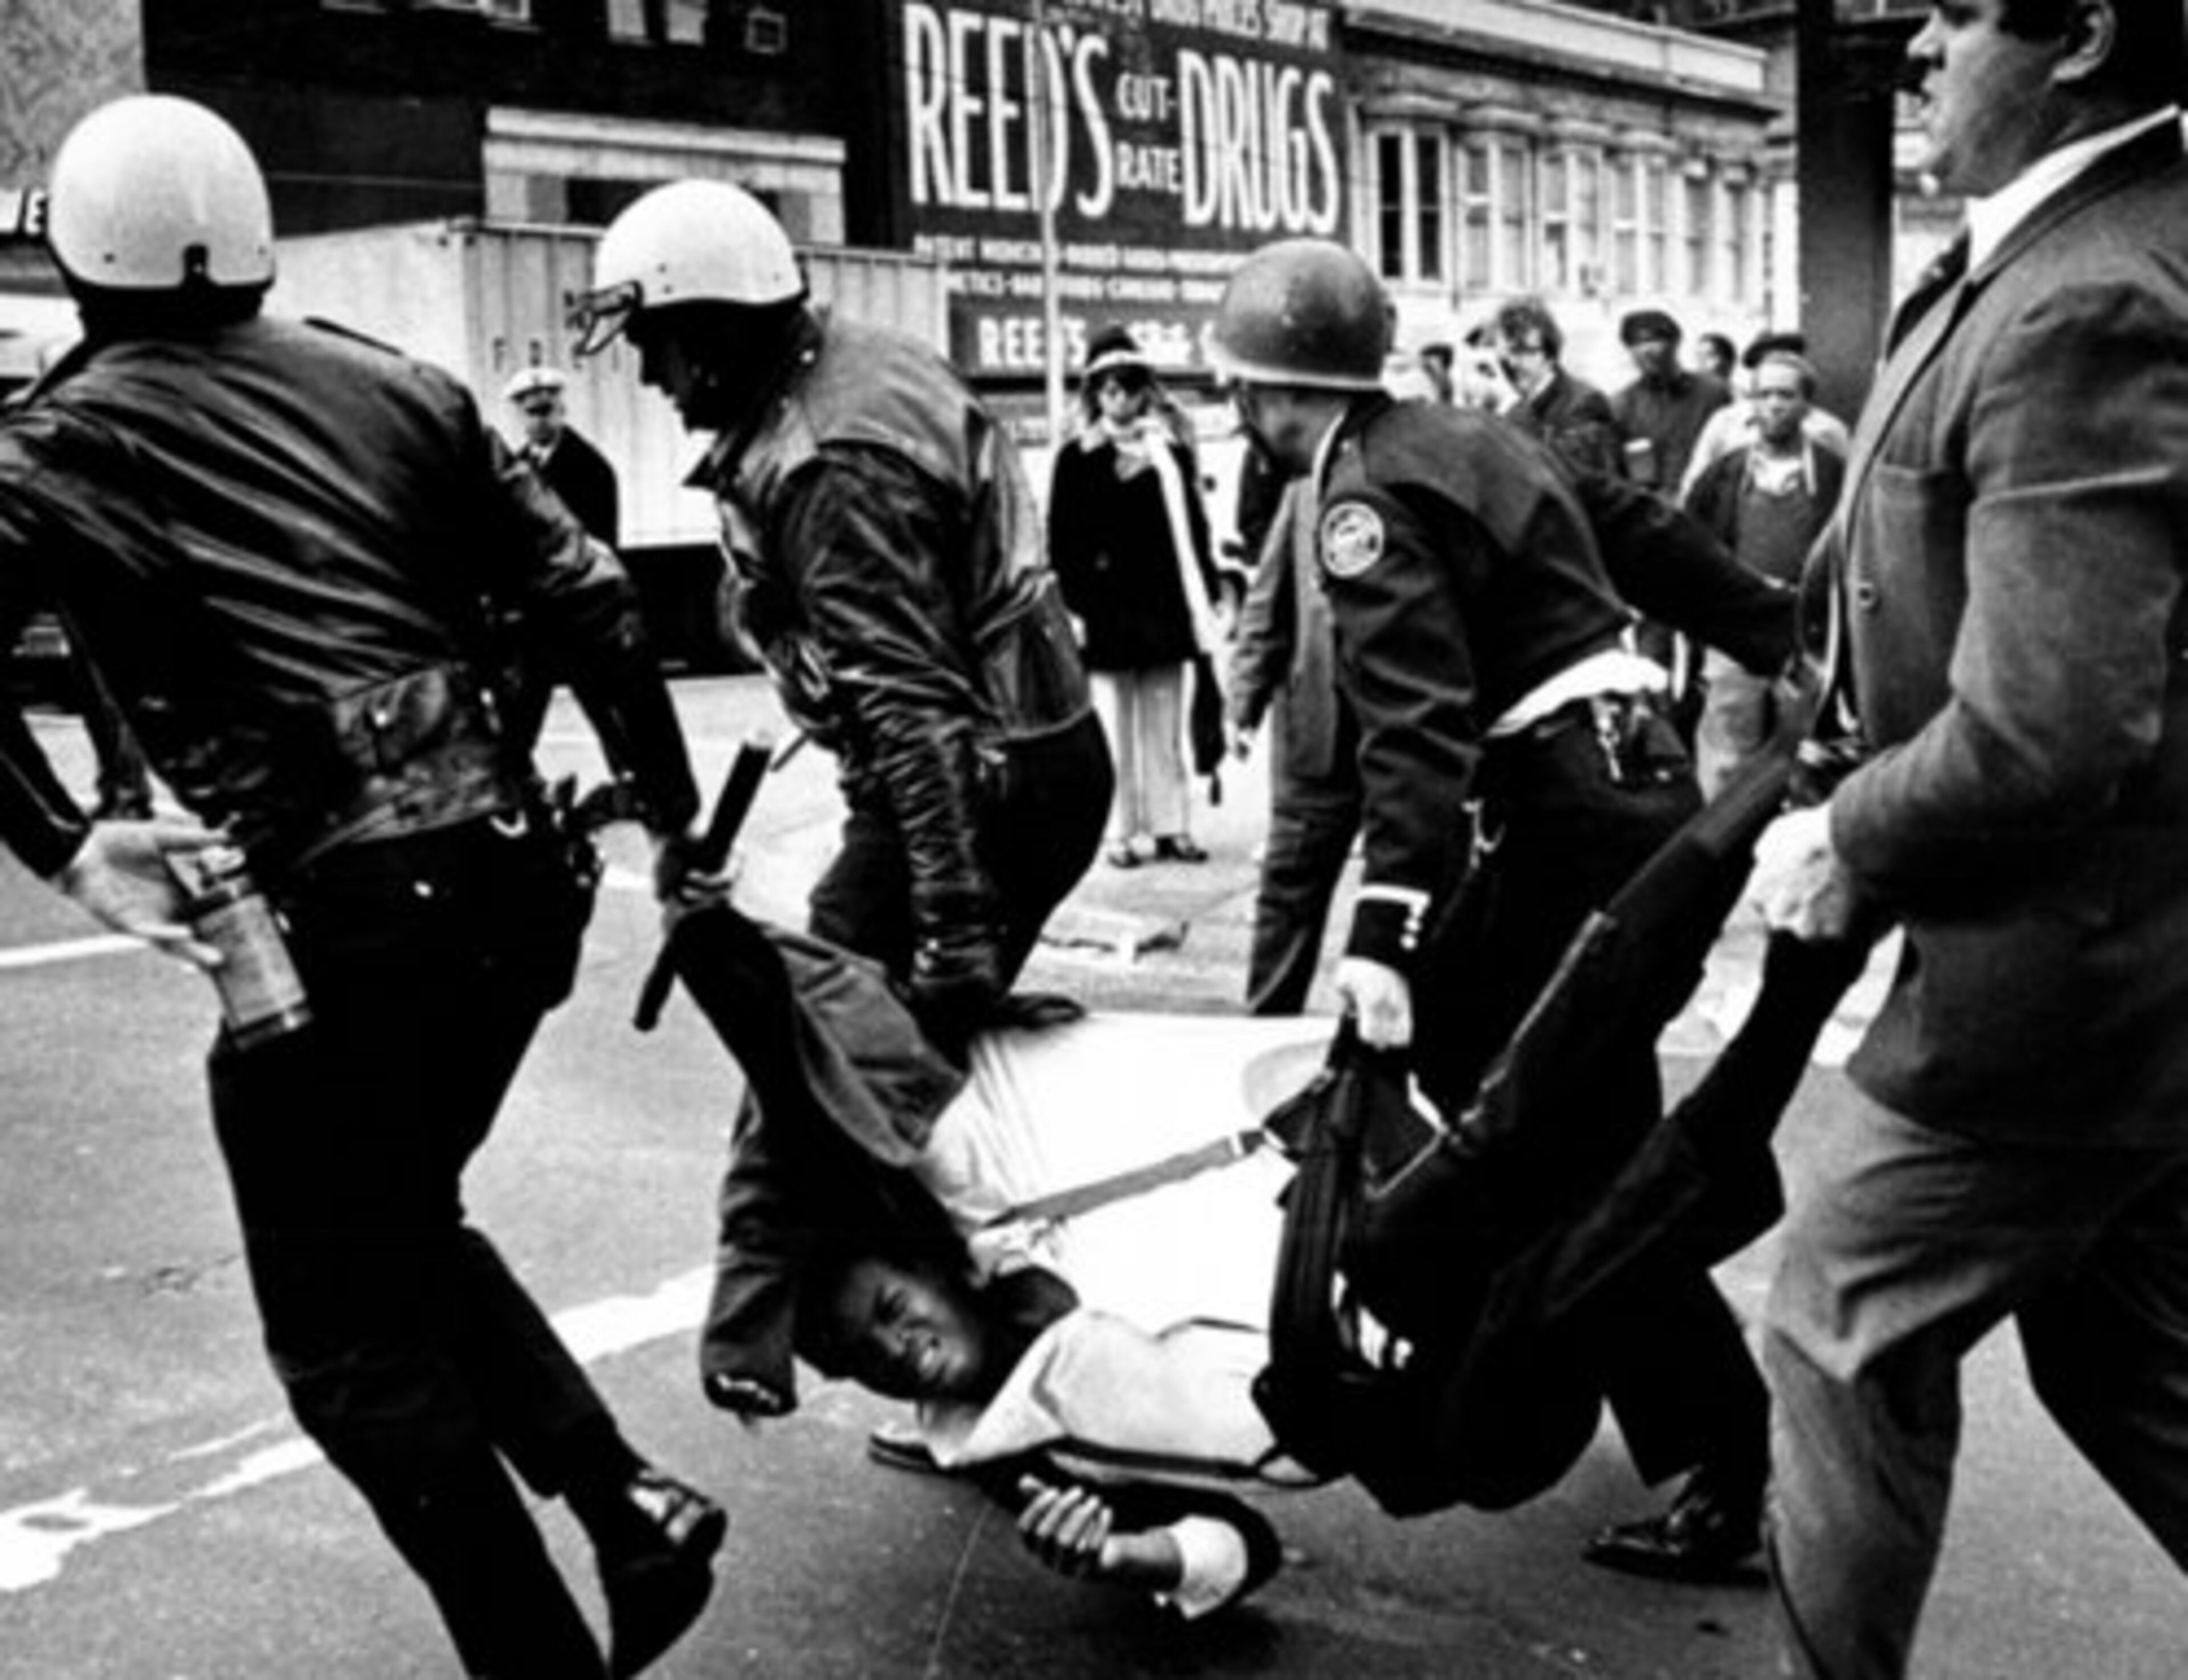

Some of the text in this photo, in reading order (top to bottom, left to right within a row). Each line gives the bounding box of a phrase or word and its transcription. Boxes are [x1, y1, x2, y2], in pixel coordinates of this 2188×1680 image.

[904, 3, 1113, 216] REED'S
[1117, 142, 1181, 191] RATE
[1178, 50, 1337, 233] DRUGS
